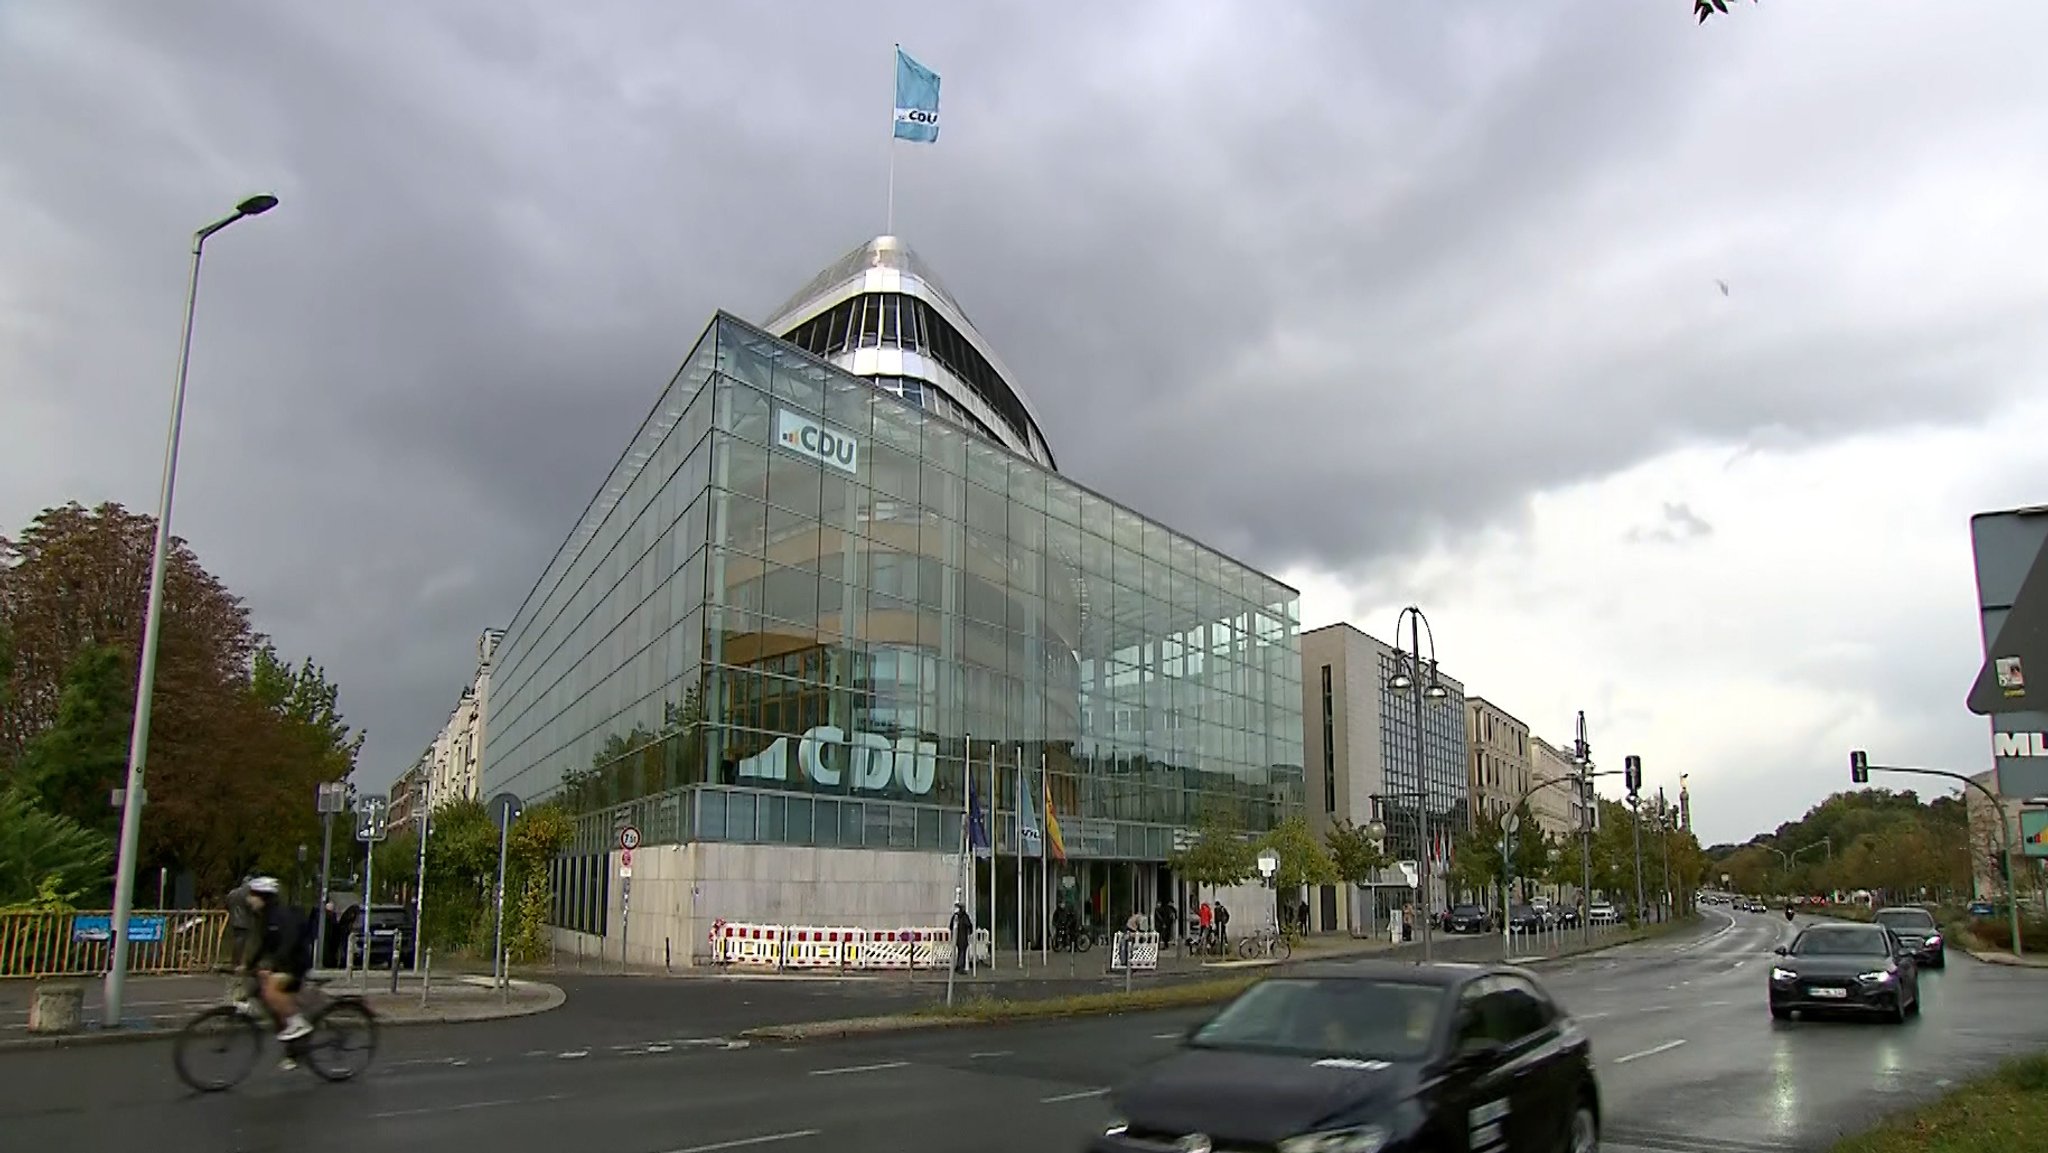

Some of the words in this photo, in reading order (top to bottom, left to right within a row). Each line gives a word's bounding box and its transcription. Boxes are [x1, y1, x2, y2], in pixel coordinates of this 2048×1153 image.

[909, 110, 938, 125] CDU
[800, 425, 854, 465] CDU
[798, 725, 937, 795] CDU
